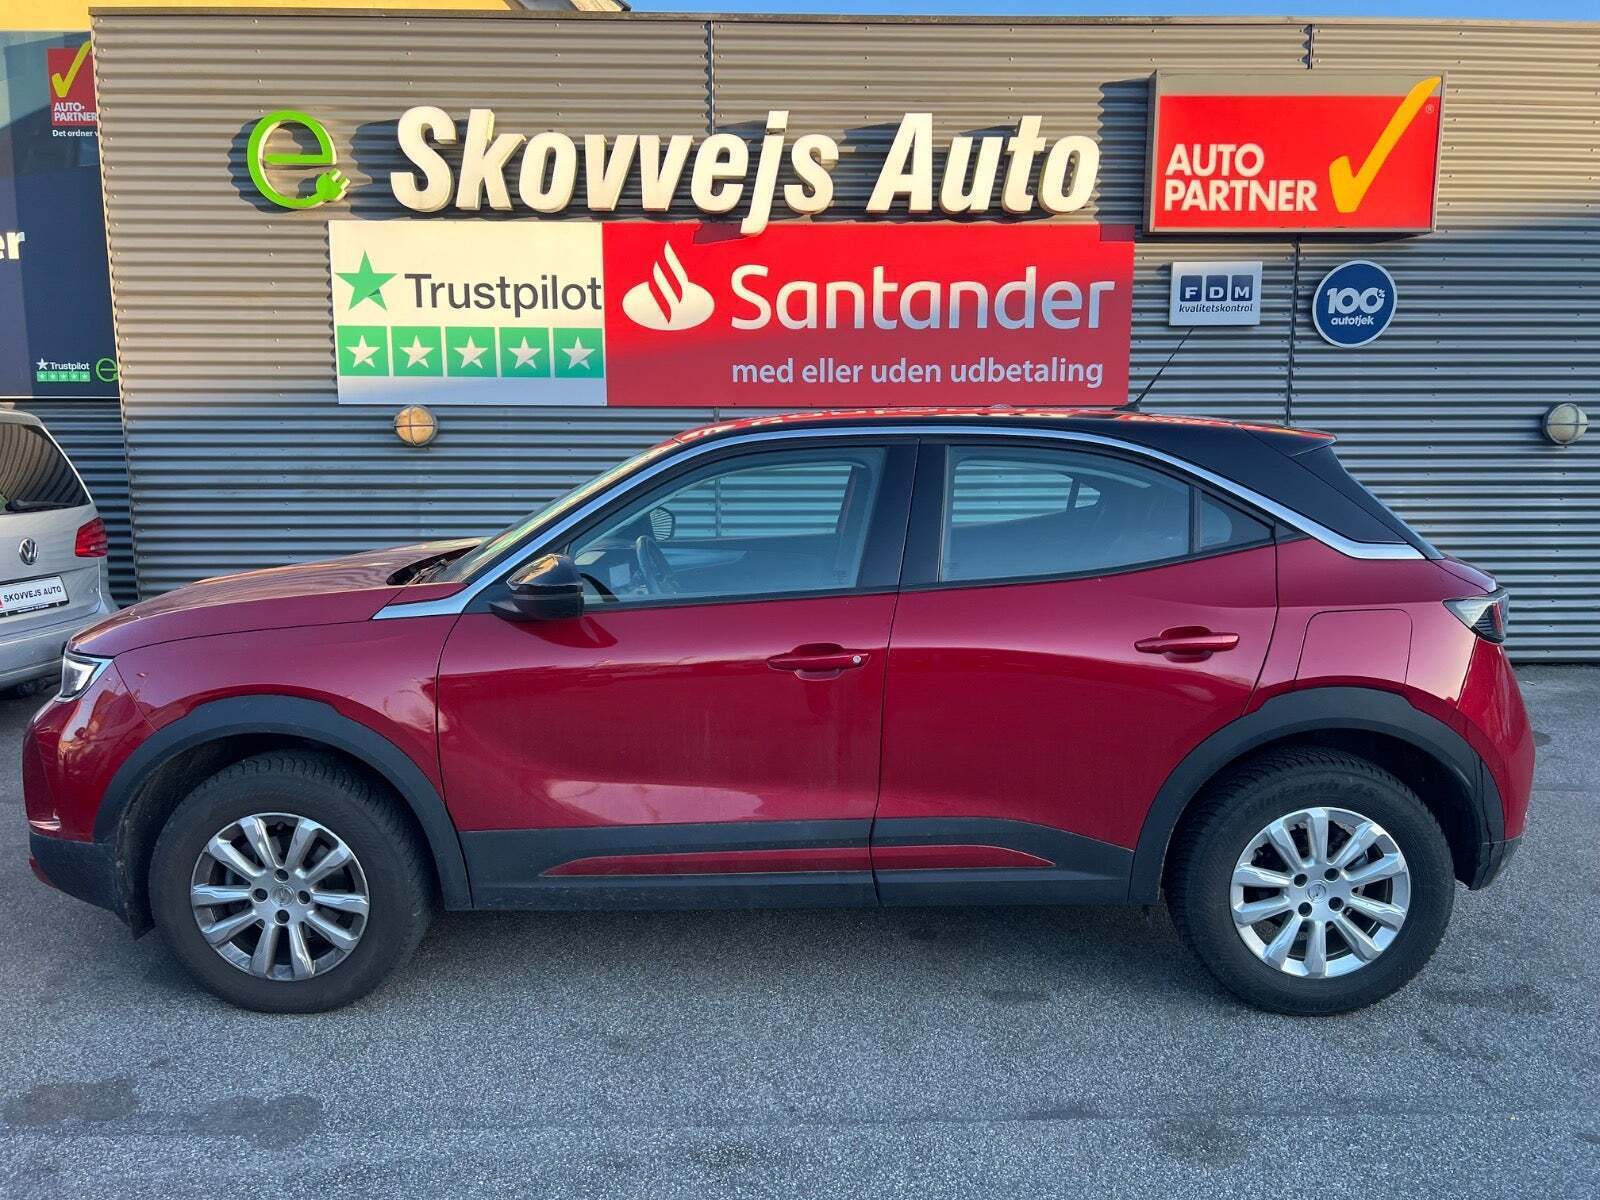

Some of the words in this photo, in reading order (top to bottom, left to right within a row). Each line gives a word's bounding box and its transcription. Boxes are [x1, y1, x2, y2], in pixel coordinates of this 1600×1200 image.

[54, 112, 97, 121] PARTNER
[52, 129, 66, 137] Det
[67, 129, 93, 137] ordner
[1165, 143, 1264, 177] AUTO
[390, 105, 840, 236] Skovvejs
[865, 112, 1101, 215] Auto
[1164, 179, 1318, 212] PARTNER
[404, 273, 602, 317] Trustpilot
[730, 264, 1115, 330] Santander
[1184, 286, 1250, 299] FDM
[1179, 303, 1253, 313] kvalitetskontrol
[1330, 315, 1375, 327] autotjek
[49, 362, 90, 372] Trustpilot
[731, 357, 794, 383] med
[801, 357, 863, 383] eller
[871, 357, 941, 383] uden
[950, 357, 1104, 388] udbetaling
[4, 590, 42, 603] SKOVVEJS
[43, 585, 62, 596] AUTO
